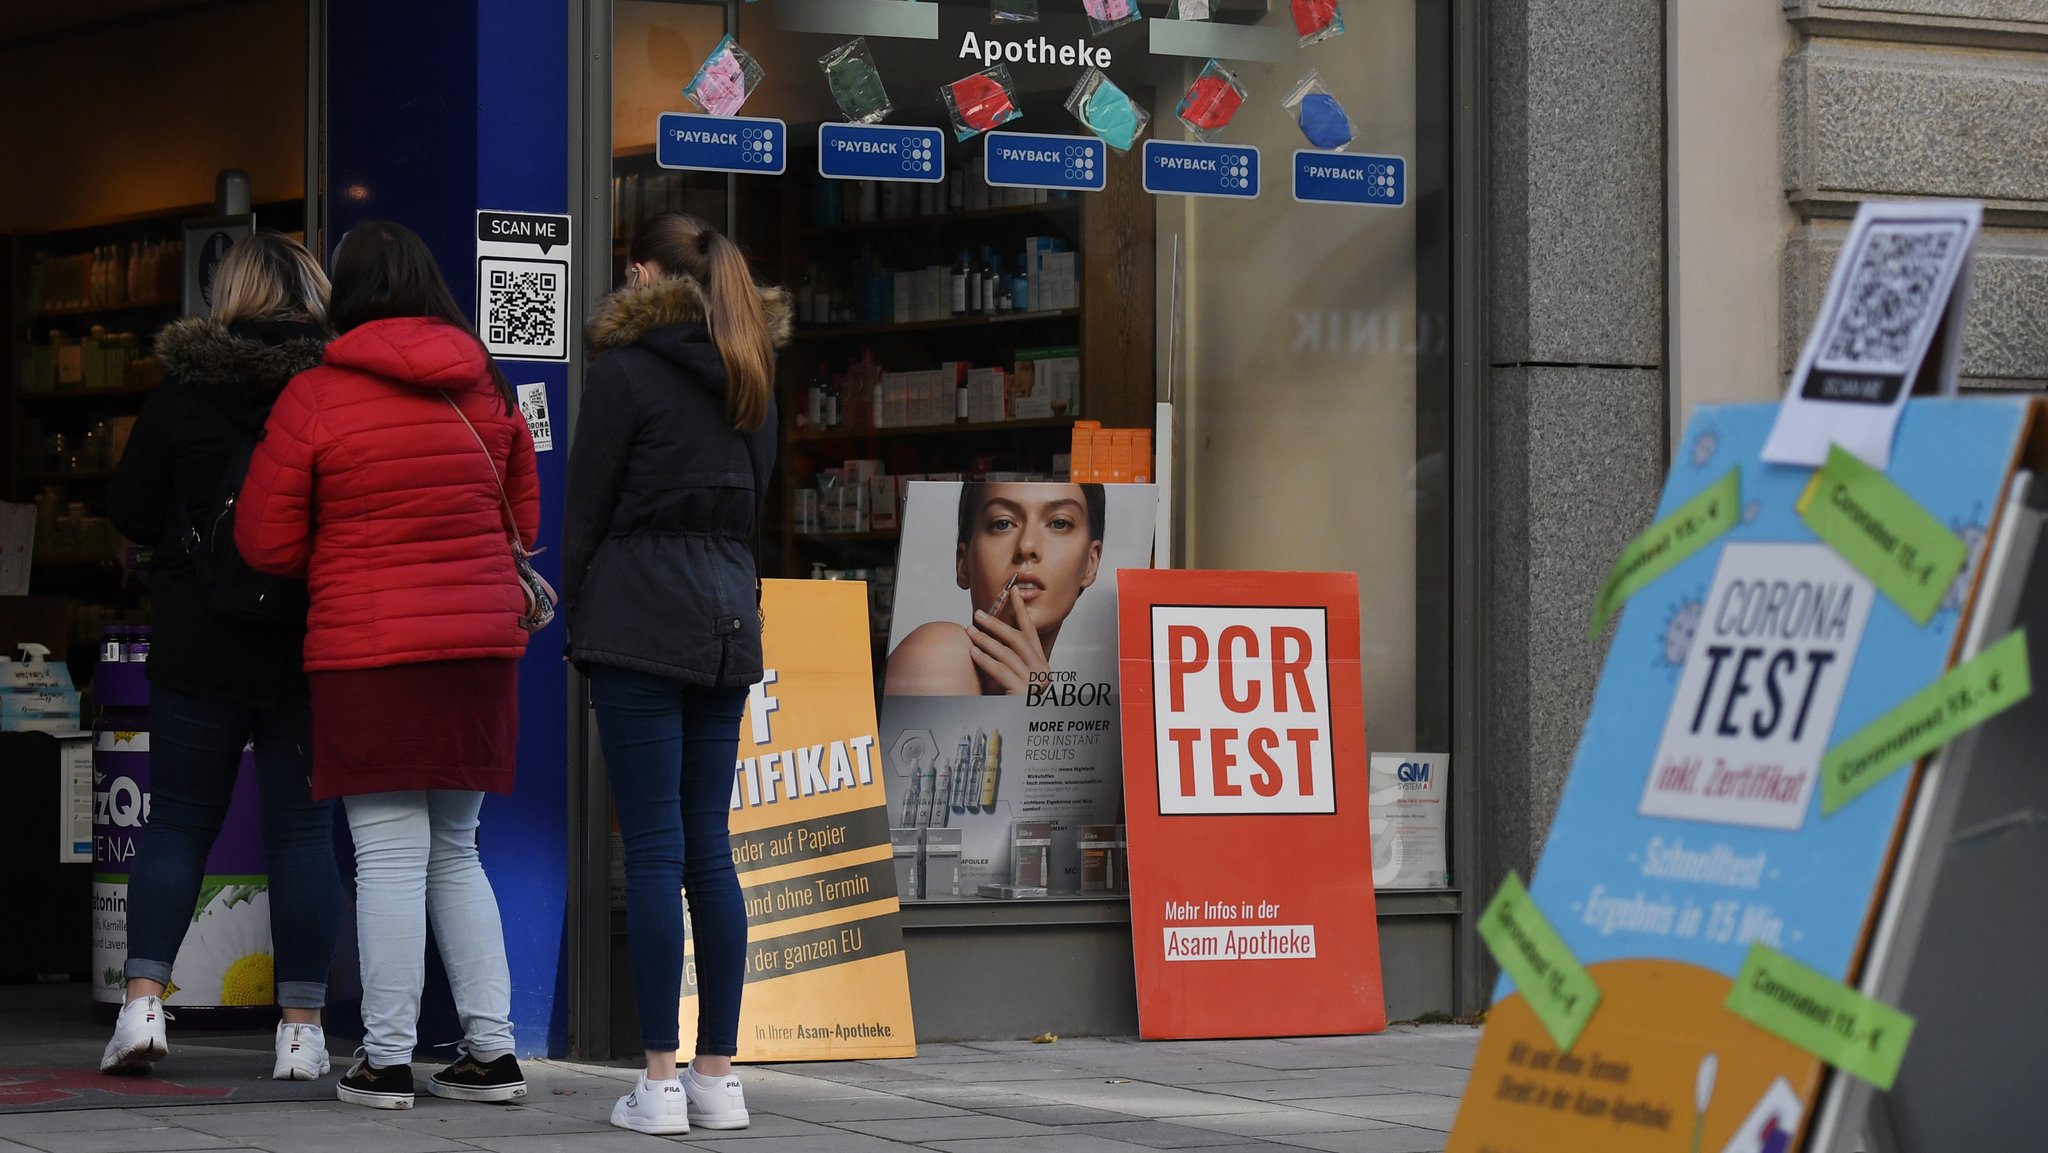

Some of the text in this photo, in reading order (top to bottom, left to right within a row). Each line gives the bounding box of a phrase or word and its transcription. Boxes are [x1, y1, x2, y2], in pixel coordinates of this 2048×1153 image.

[959, 31, 1112, 68] Apotheke
[676, 130, 738, 146] PAYBACK
[837, 140, 898, 155] PAYBACK
[1003, 148, 1061, 164] PAYBACK
[1160, 156, 1217, 171] PAYBACK
[1309, 166, 1365, 181] PAYBACK
[491, 219, 557, 238] SCAN ME
[527, 421, 549, 430] ORONA
[530, 428, 550, 438] EKTE
[1713, 579, 1854, 642] CORONA
[1029, 671, 1077, 682] DOCTOR
[1167, 624, 1317, 714] PCR
[1026, 682, 1112, 707] BABOR
[1689, 644, 1837, 743] TEST
[1028, 720, 1110, 732] MORE POWER
[1026, 734, 1101, 746] FOR INSTANT
[1025, 748, 1076, 760] RESULTS
[1168, 727, 1319, 797] TEST
[730, 735, 874, 811] TIFIKAT
[1397, 762, 1430, 782] QM
[1703, 757, 1808, 803] Zertifikat
[1397, 782, 1422, 790] SYSTEM
[108, 836, 136, 862] NA
[732, 825, 846, 865] oder auf Papier
[745, 874, 870, 918] und ohne Termin
[1165, 900, 1280, 920] Mehr Infos in der
[104, 938, 128, 950] Laven
[755, 947, 779, 972] der
[784, 938, 837, 970] ganzen
[841, 927, 863, 953] EU
[1168, 929, 1310, 960] Asam Apotheke
[755, 1022, 895, 1041] In Ihrer Asam-Apotheke.
